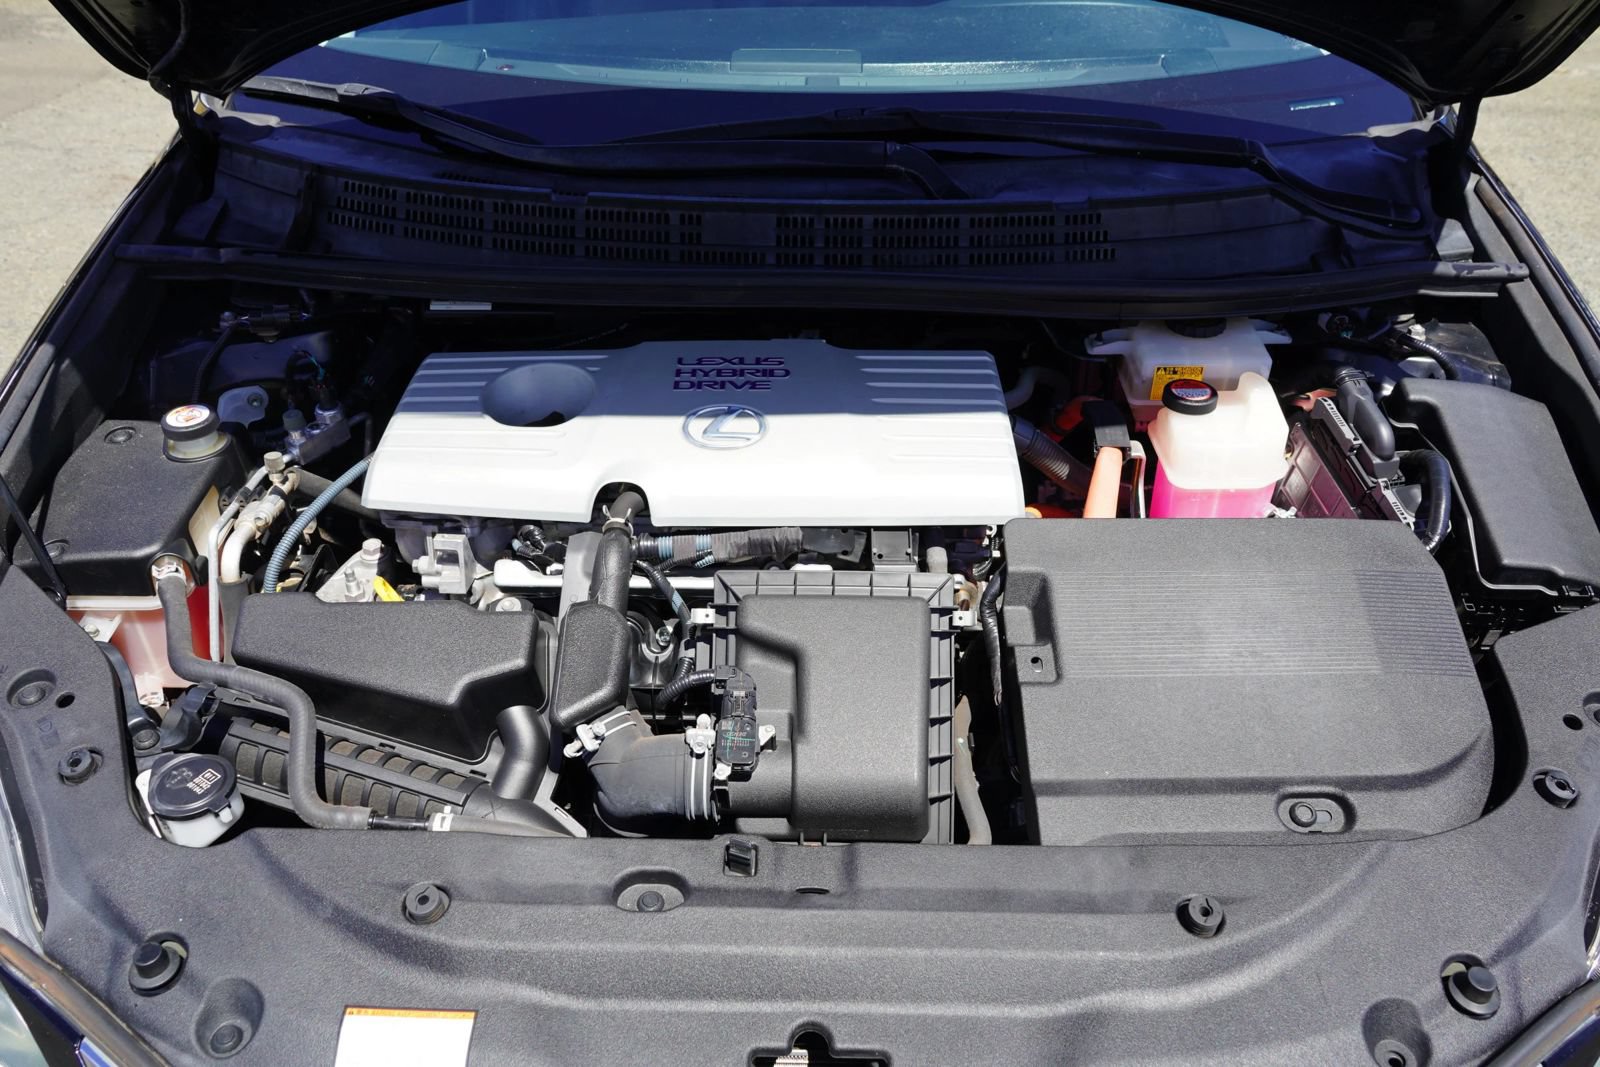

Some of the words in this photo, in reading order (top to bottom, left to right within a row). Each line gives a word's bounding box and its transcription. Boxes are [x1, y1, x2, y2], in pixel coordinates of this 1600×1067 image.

[677, 356, 785, 367] LEXUS
[675, 368, 791, 379] HYBRID
[673, 380, 772, 391] DRIVE
